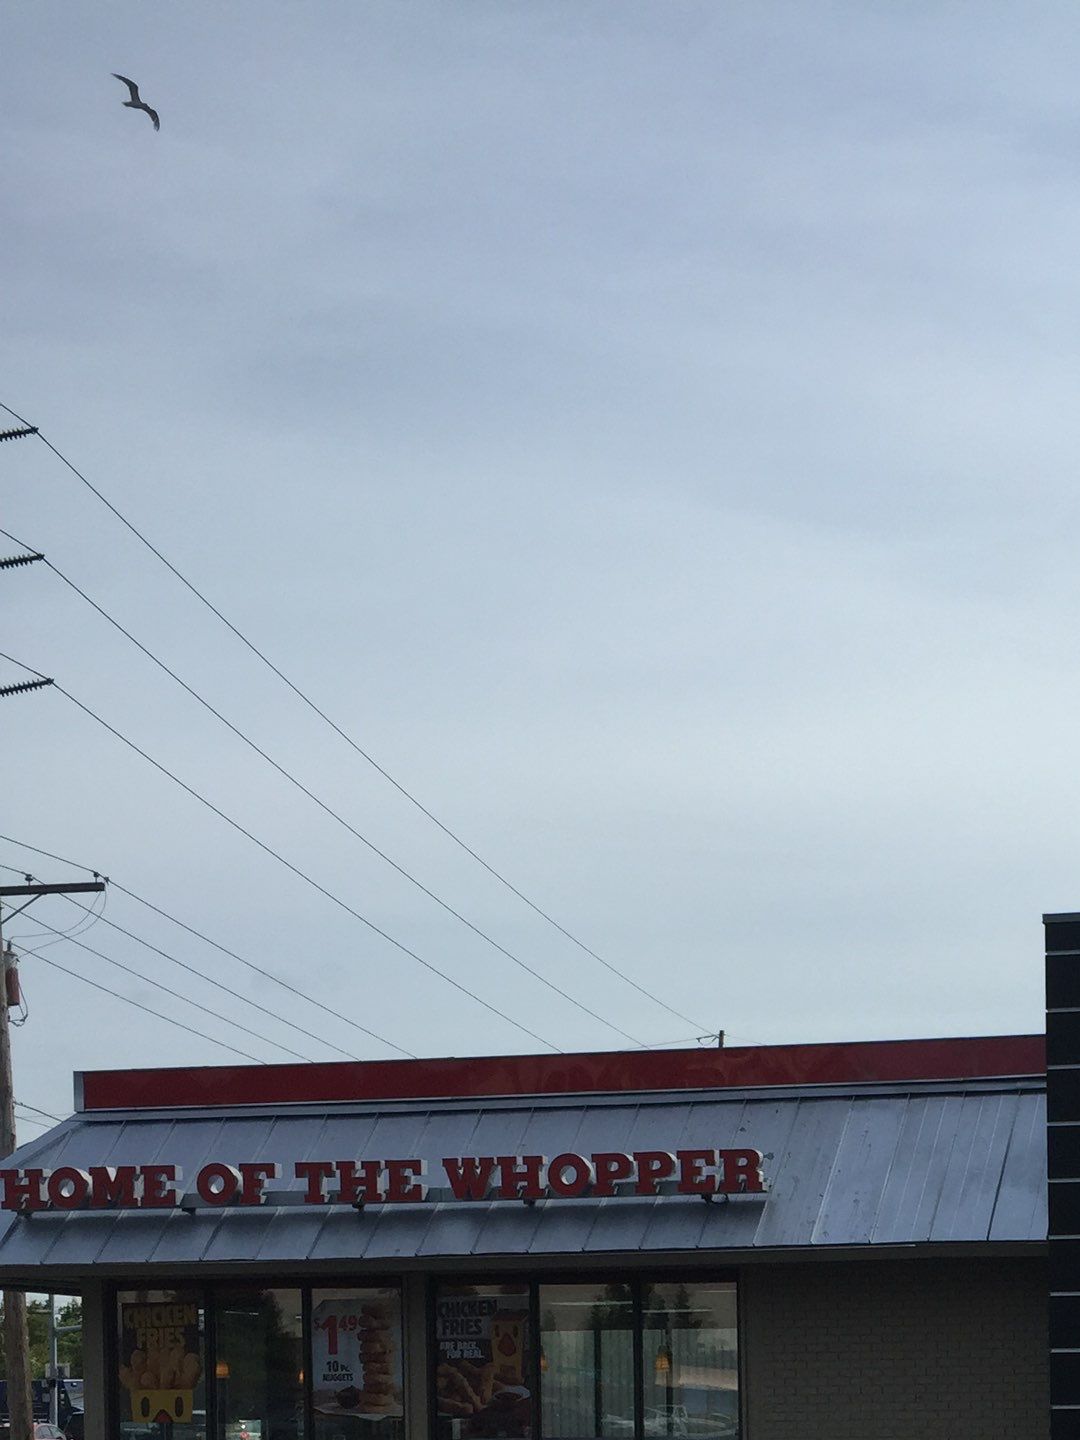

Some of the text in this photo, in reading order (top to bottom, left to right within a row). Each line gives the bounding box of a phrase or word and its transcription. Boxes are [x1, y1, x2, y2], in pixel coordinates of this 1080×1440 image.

[0, 1149, 765, 1208] HOME OF THE WHOPPER
[439, 1300, 497, 1318] CHICKEN
[442, 1318, 482, 1336] FRIES
[136, 1327, 187, 1350] FRIES
[326, 1360, 339, 1372] 10
[323, 1373, 354, 1382] NUGGETS
